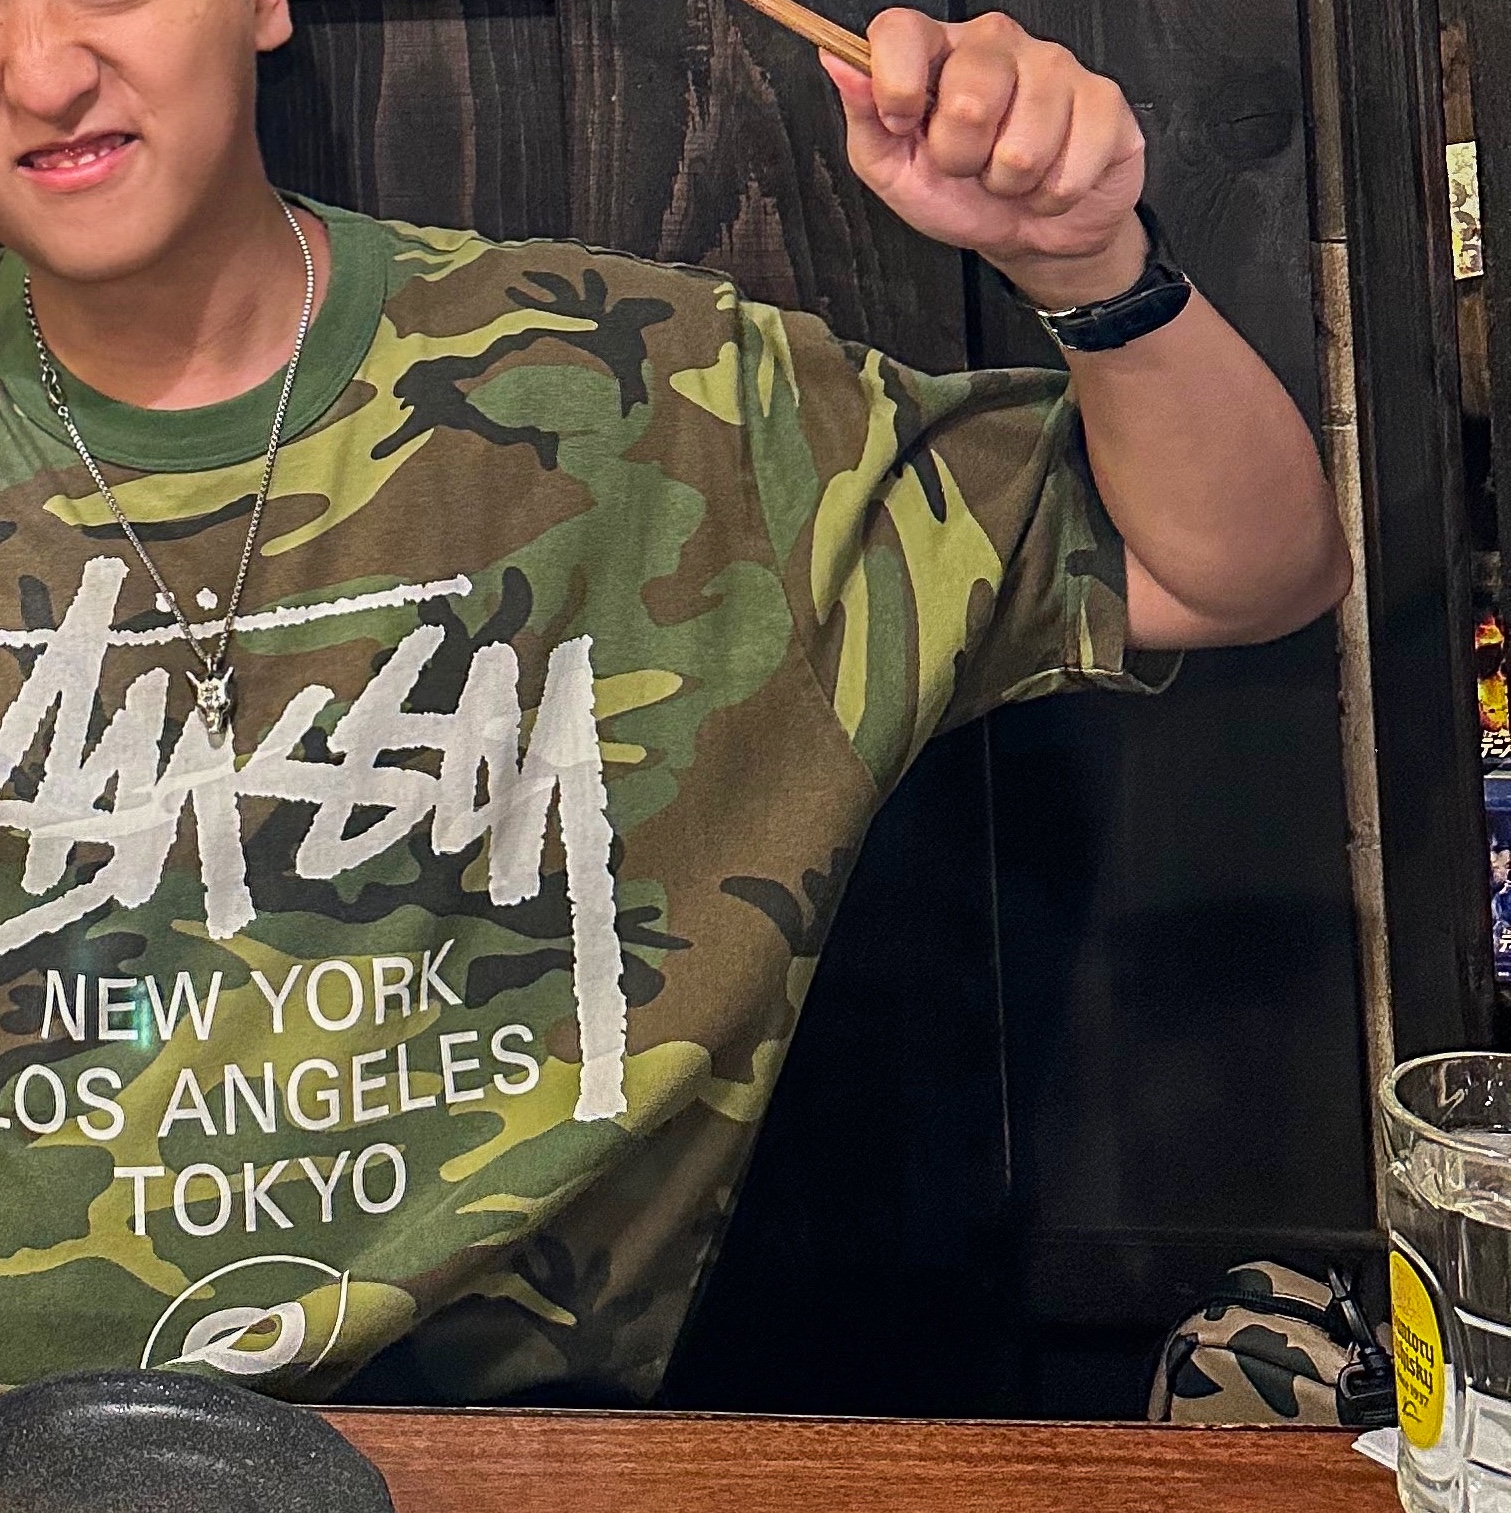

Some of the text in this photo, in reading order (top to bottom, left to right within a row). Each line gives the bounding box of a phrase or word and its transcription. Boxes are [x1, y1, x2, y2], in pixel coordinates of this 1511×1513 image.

[40, 938, 463, 1043] NEW YORK
[159, 1024, 542, 1140] ANGELES
[113, 1143, 408, 1238] TOKYO
